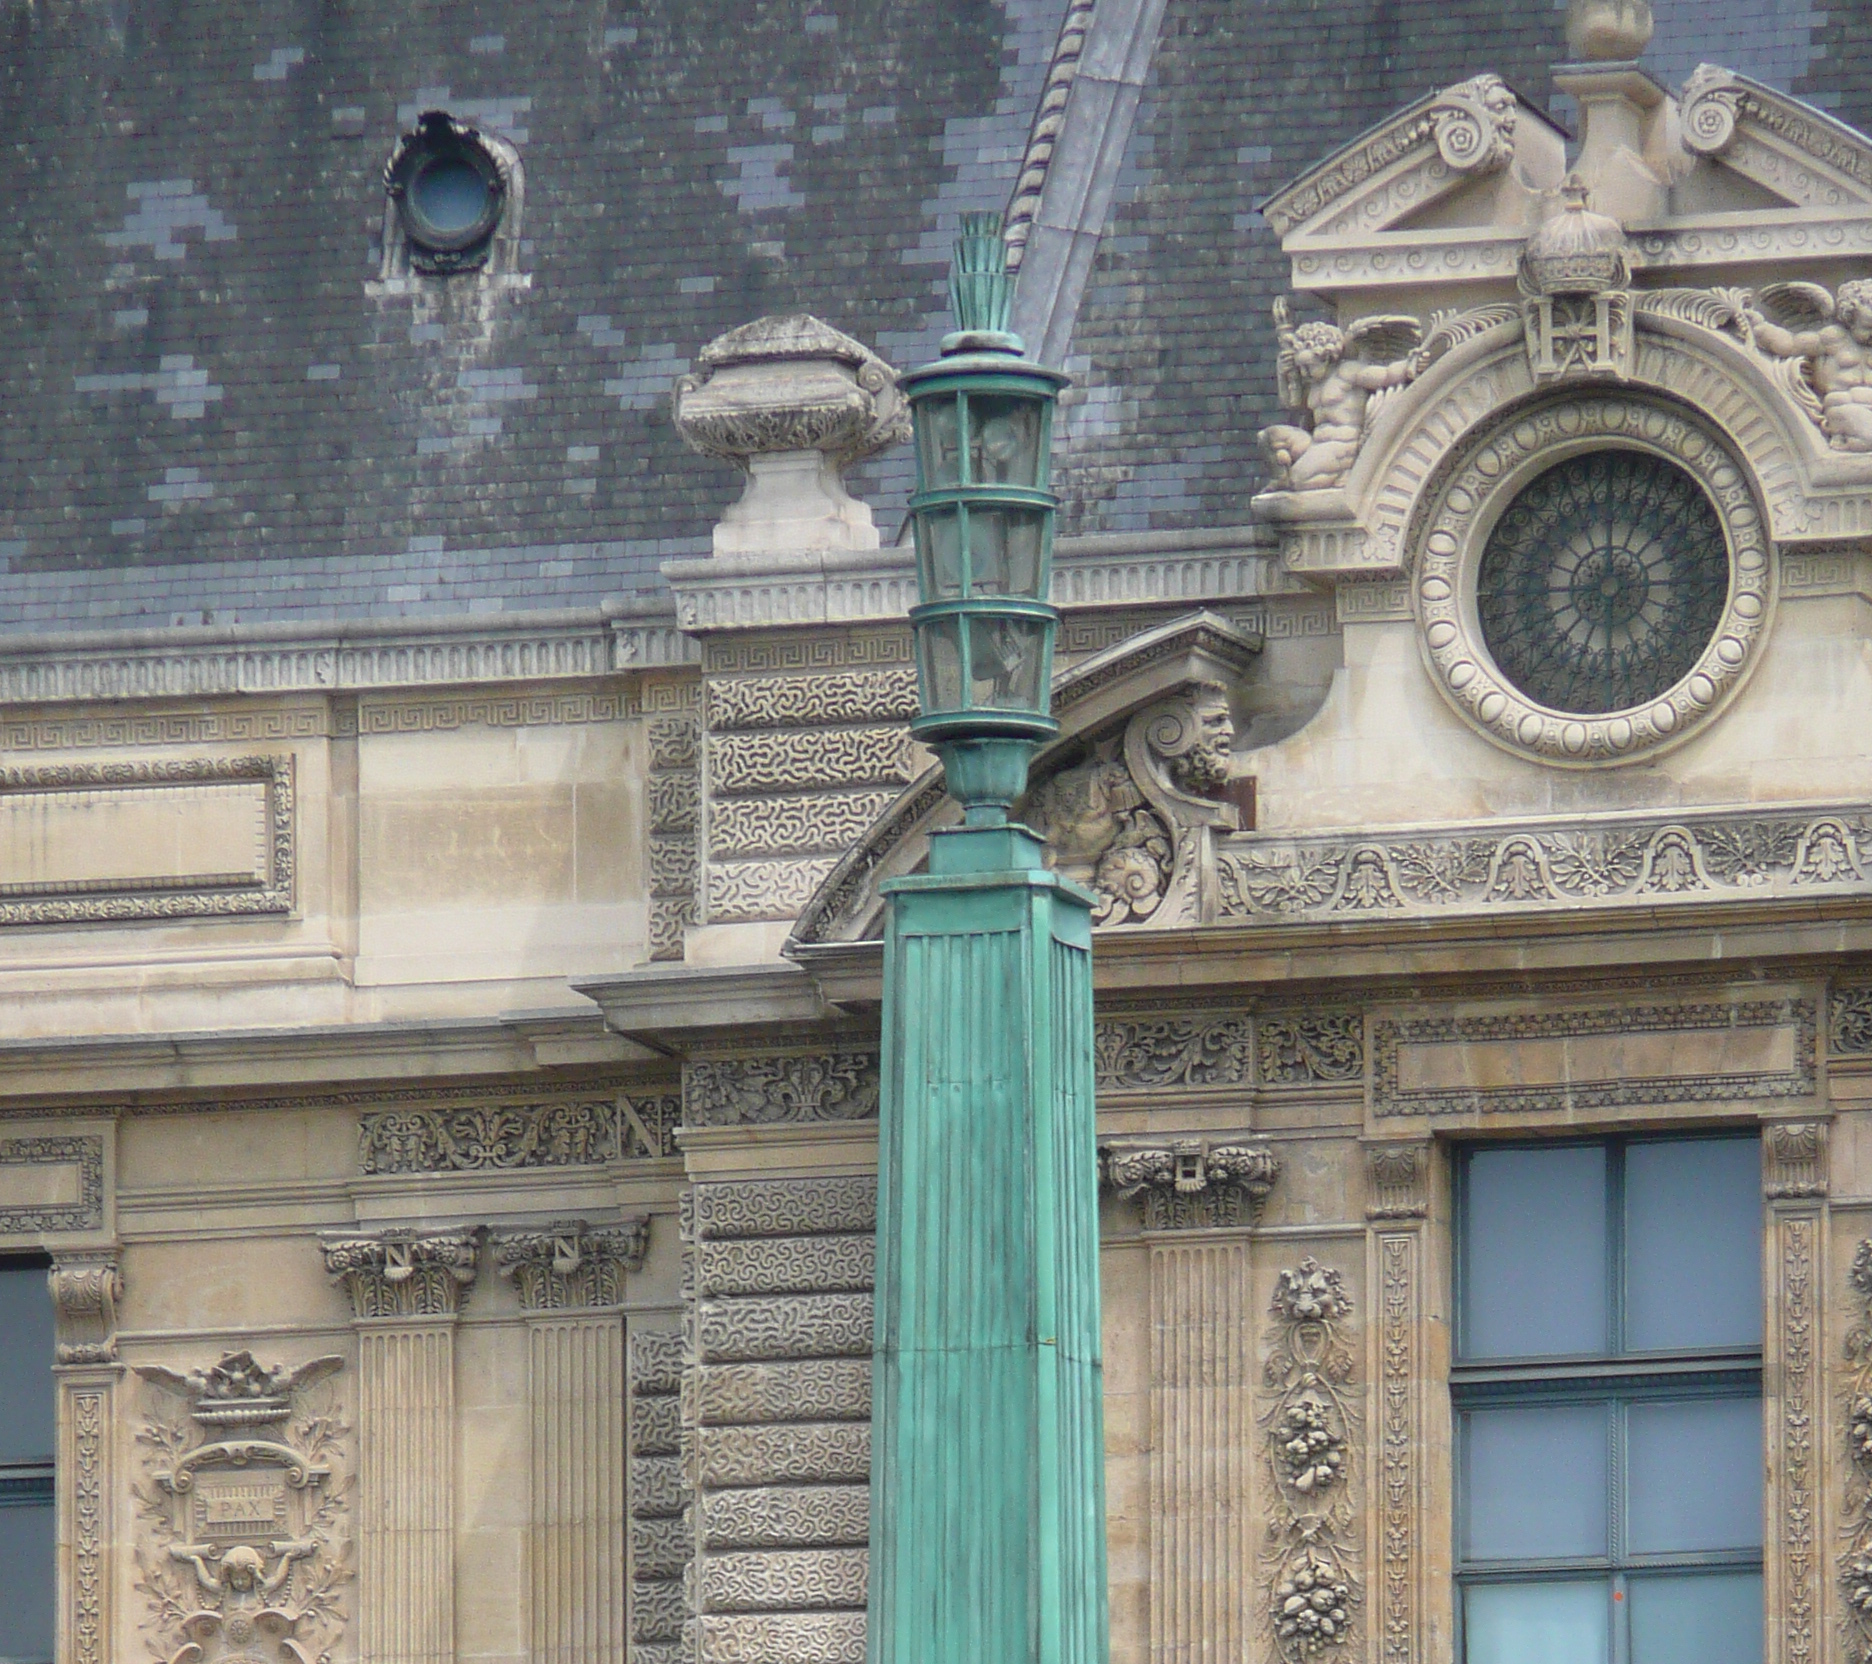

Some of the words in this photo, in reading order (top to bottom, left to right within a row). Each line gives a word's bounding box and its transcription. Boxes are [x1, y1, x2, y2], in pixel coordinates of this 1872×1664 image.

[617, 1094, 663, 1158] N
[386, 1243, 409, 1268] N
[555, 1236, 579, 1260] N
[221, 1501, 260, 1518] PAX
